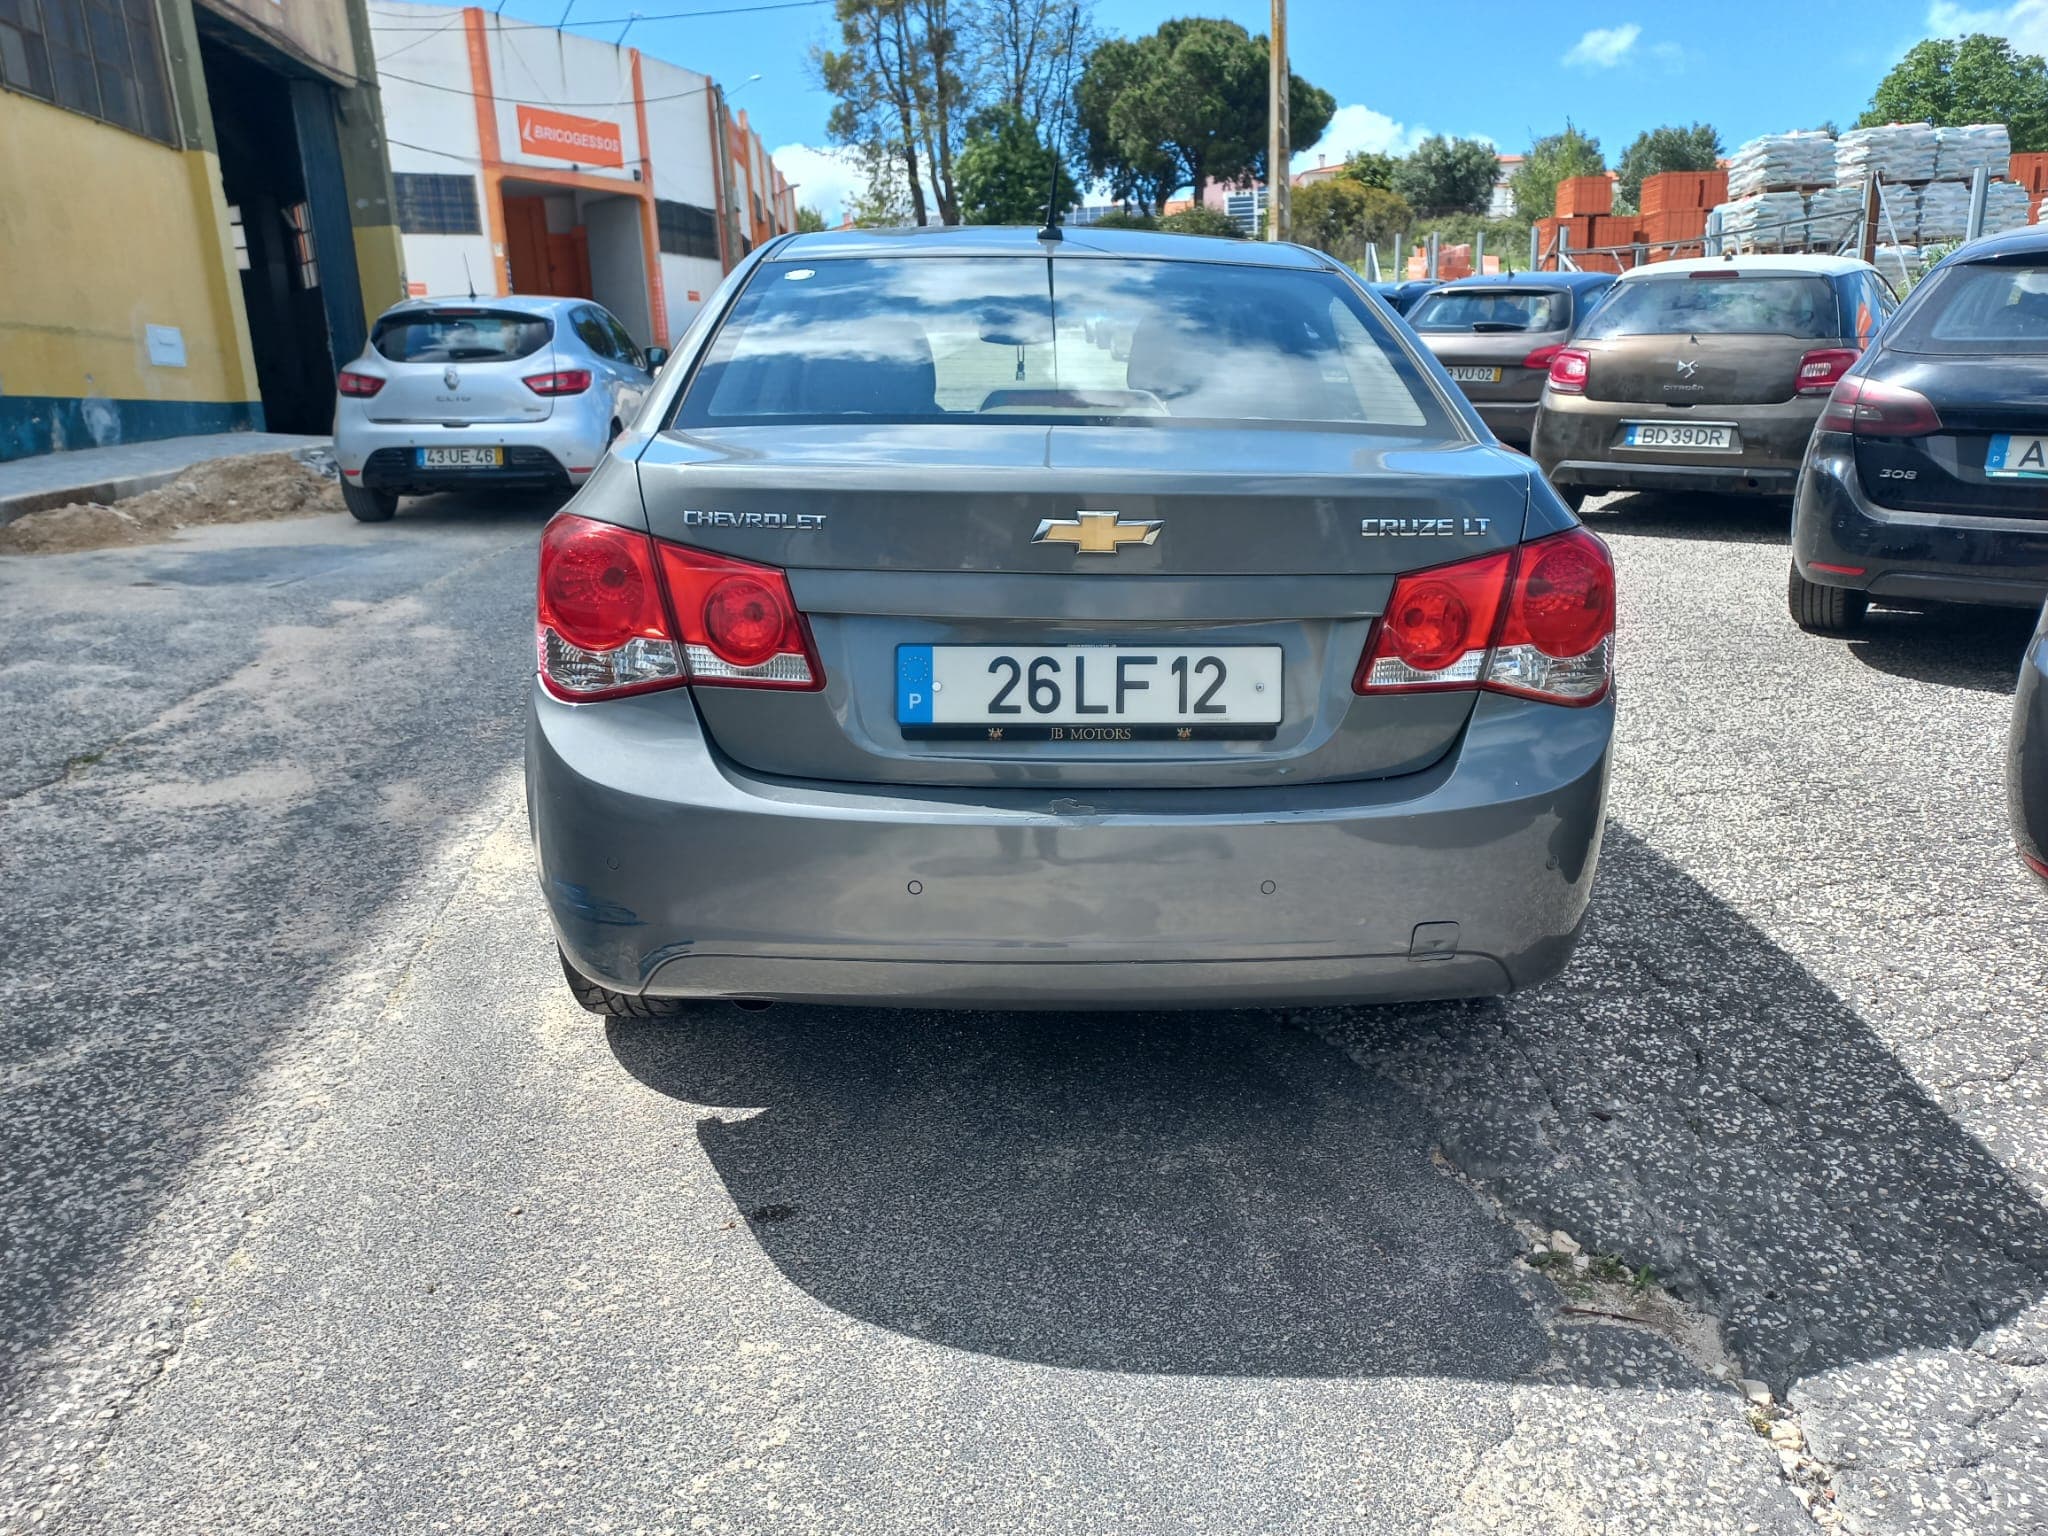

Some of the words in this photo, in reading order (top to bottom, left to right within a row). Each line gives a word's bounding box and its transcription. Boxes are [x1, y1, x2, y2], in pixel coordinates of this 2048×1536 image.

[534, 125, 620, 152] BRICOGESSOS
[1879, 468, 1918, 480] 308
[683, 510, 827, 530] CHEVROLET
[1361, 518, 1454, 537] CRUZE
[1463, 518, 1491, 536] LT
[908, 693, 922, 710] P
[1049, 727, 1064, 741] JB
[1070, 727, 1132, 741] MOTORS
